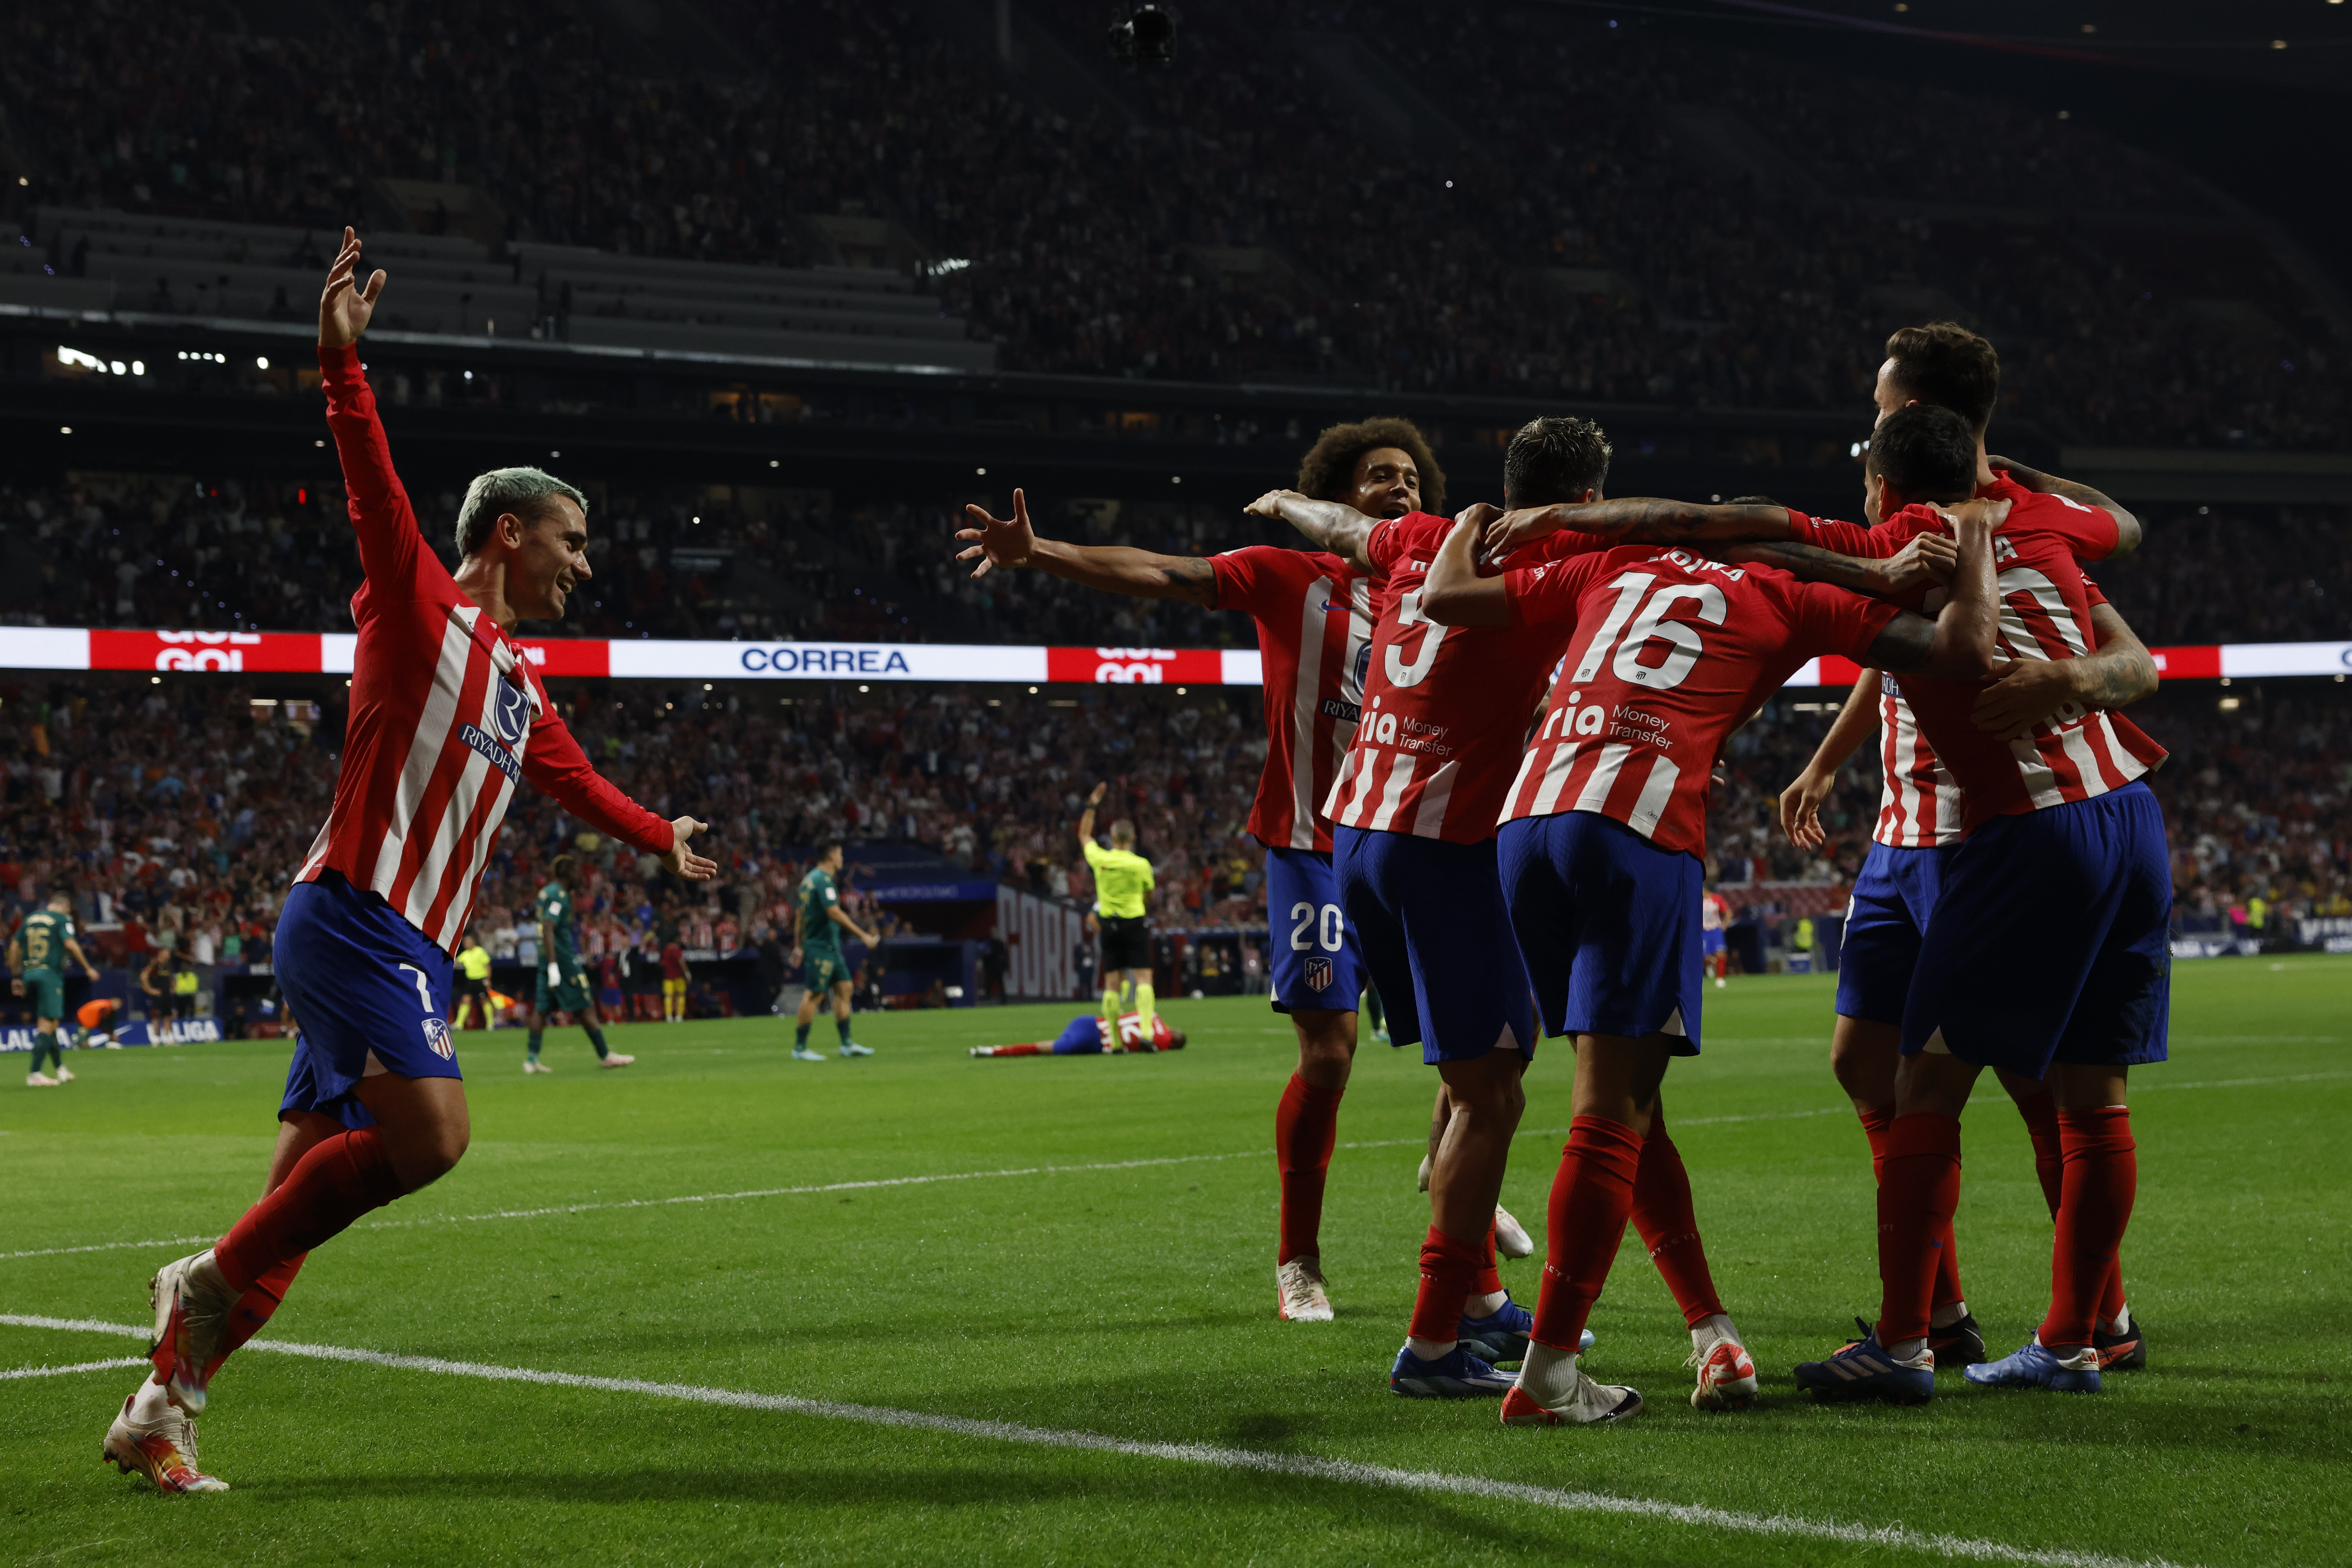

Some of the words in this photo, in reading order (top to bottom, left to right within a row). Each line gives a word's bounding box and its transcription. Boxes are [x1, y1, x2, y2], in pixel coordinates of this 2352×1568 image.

[1570, 571, 1727, 690] 16
[742, 649, 910, 673] CORREA
[1324, 700, 1359, 721] RIYA
[1360, 695, 1397, 745] ria
[1542, 690, 1605, 741] ria
[1612, 704, 1671, 732] Money
[1403, 716, 1449, 740] Money
[1609, 722, 1673, 750] Transfer
[462, 725, 512, 773] RIYADH
[1400, 733, 1453, 756] Transfer
[25, 926, 51, 958] 15
[1291, 901, 1344, 952] 20
[399, 963, 434, 1013] 7
